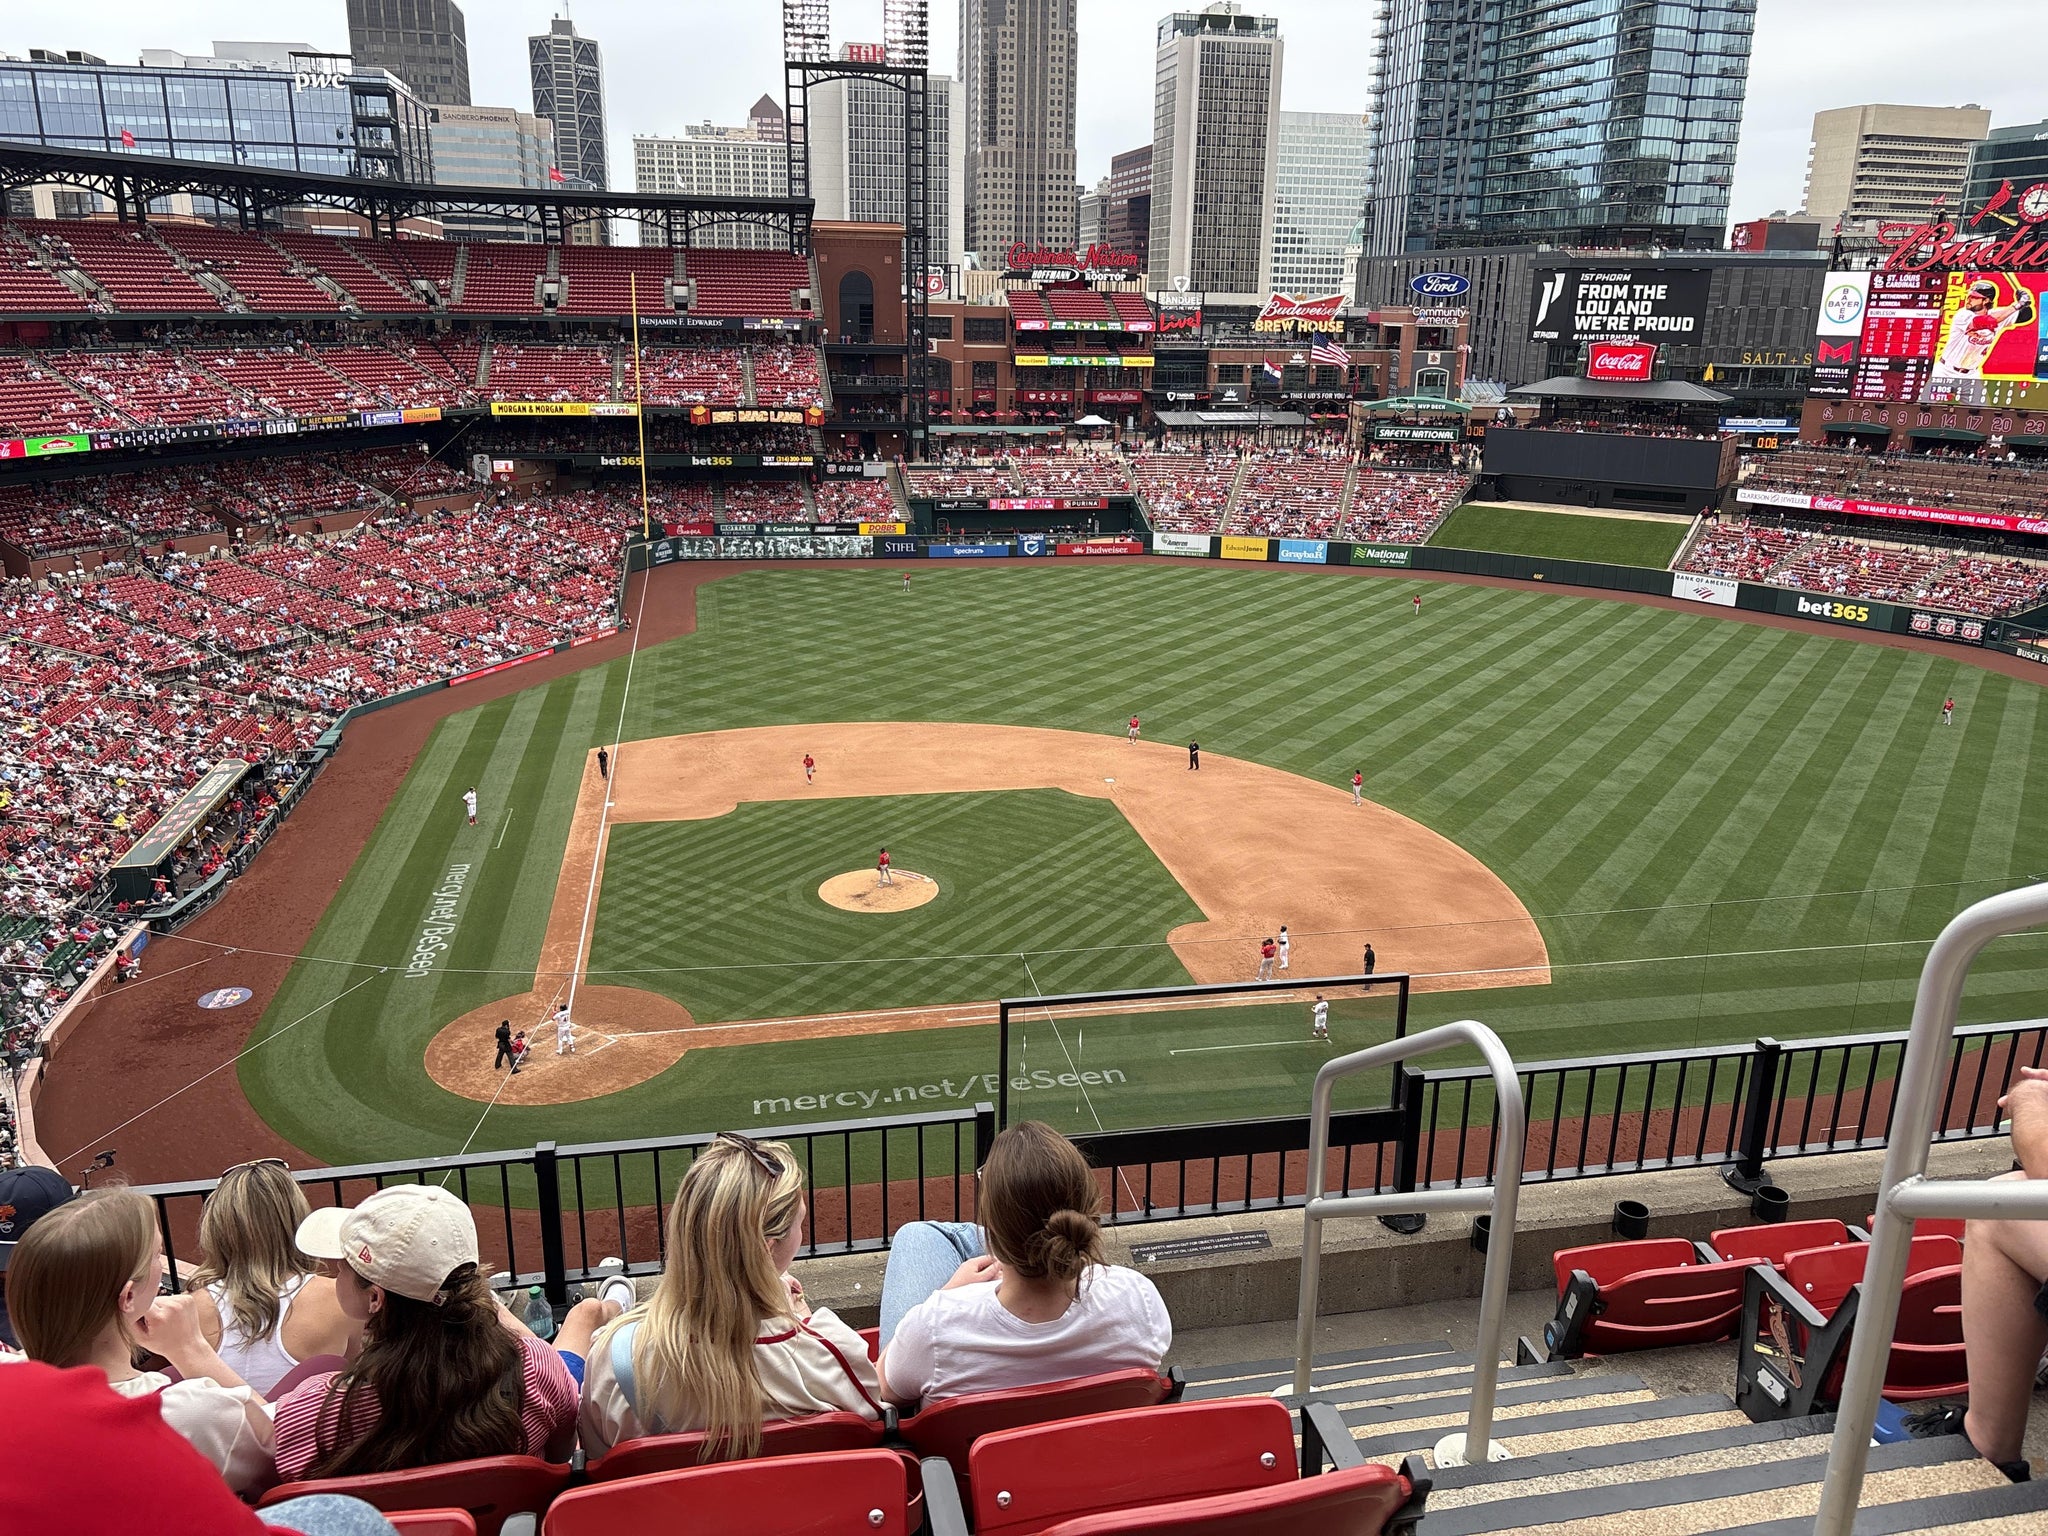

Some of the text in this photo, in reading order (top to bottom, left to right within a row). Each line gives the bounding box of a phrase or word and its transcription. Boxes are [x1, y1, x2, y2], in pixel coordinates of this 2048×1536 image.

[294, 72, 345, 92] pwc
[1008, 242, 1138, 270] Cardinals Nation
[1032, 270, 1072, 280] HOFFMANN
[1422, 276, 1459, 292] Ford
[1578, 284, 1668, 299] FROM THE
[1257, 300, 1344, 316] Budweiser
[1412, 307, 1466, 318] Community
[1576, 300, 1652, 315] LOU AND
[679, 318, 685, 326] F.
[1160, 310, 1202, 332] Live!
[1254, 320, 1344, 332] BREW HOUSE
[1574, 316, 1694, 331] WE'RE PROUD
[1596, 353, 1645, 370] Coca-Cola
[1742, 352, 1786, 364] SALT
[498, 405, 526, 413] MORGAN
[528, 405, 534, 413] &
[535, 405, 564, 413] MORGAN
[738, 410, 769, 422] MAC
[1848, 408, 2046, 435] 1 2 6 9 10 14 17 20 23
[1412, 430, 1454, 439] NATIONAL
[1757, 438, 1778, 449] 0:08
[600, 456, 642, 465] bet365
[692, 456, 733, 465] bet365
[1740, 492, 1808, 505] CLARKSON JEWELERS
[1908, 510, 1929, 518] PROUD
[1930, 512, 1957, 521] BROOKE!
[1976, 516, 1990, 524] AND
[884, 542, 916, 552] STIFEL
[1366, 549, 1408, 559] National
[1705, 579, 1736, 588] AMERICA
[1797, 596, 1869, 622] bet365
[1940, 624, 1952, 632] 66
[1964, 628, 1977, 636] 66
[2017, 648, 2040, 661] BUSCH
[1767, 1380, 1774, 1390] 2
